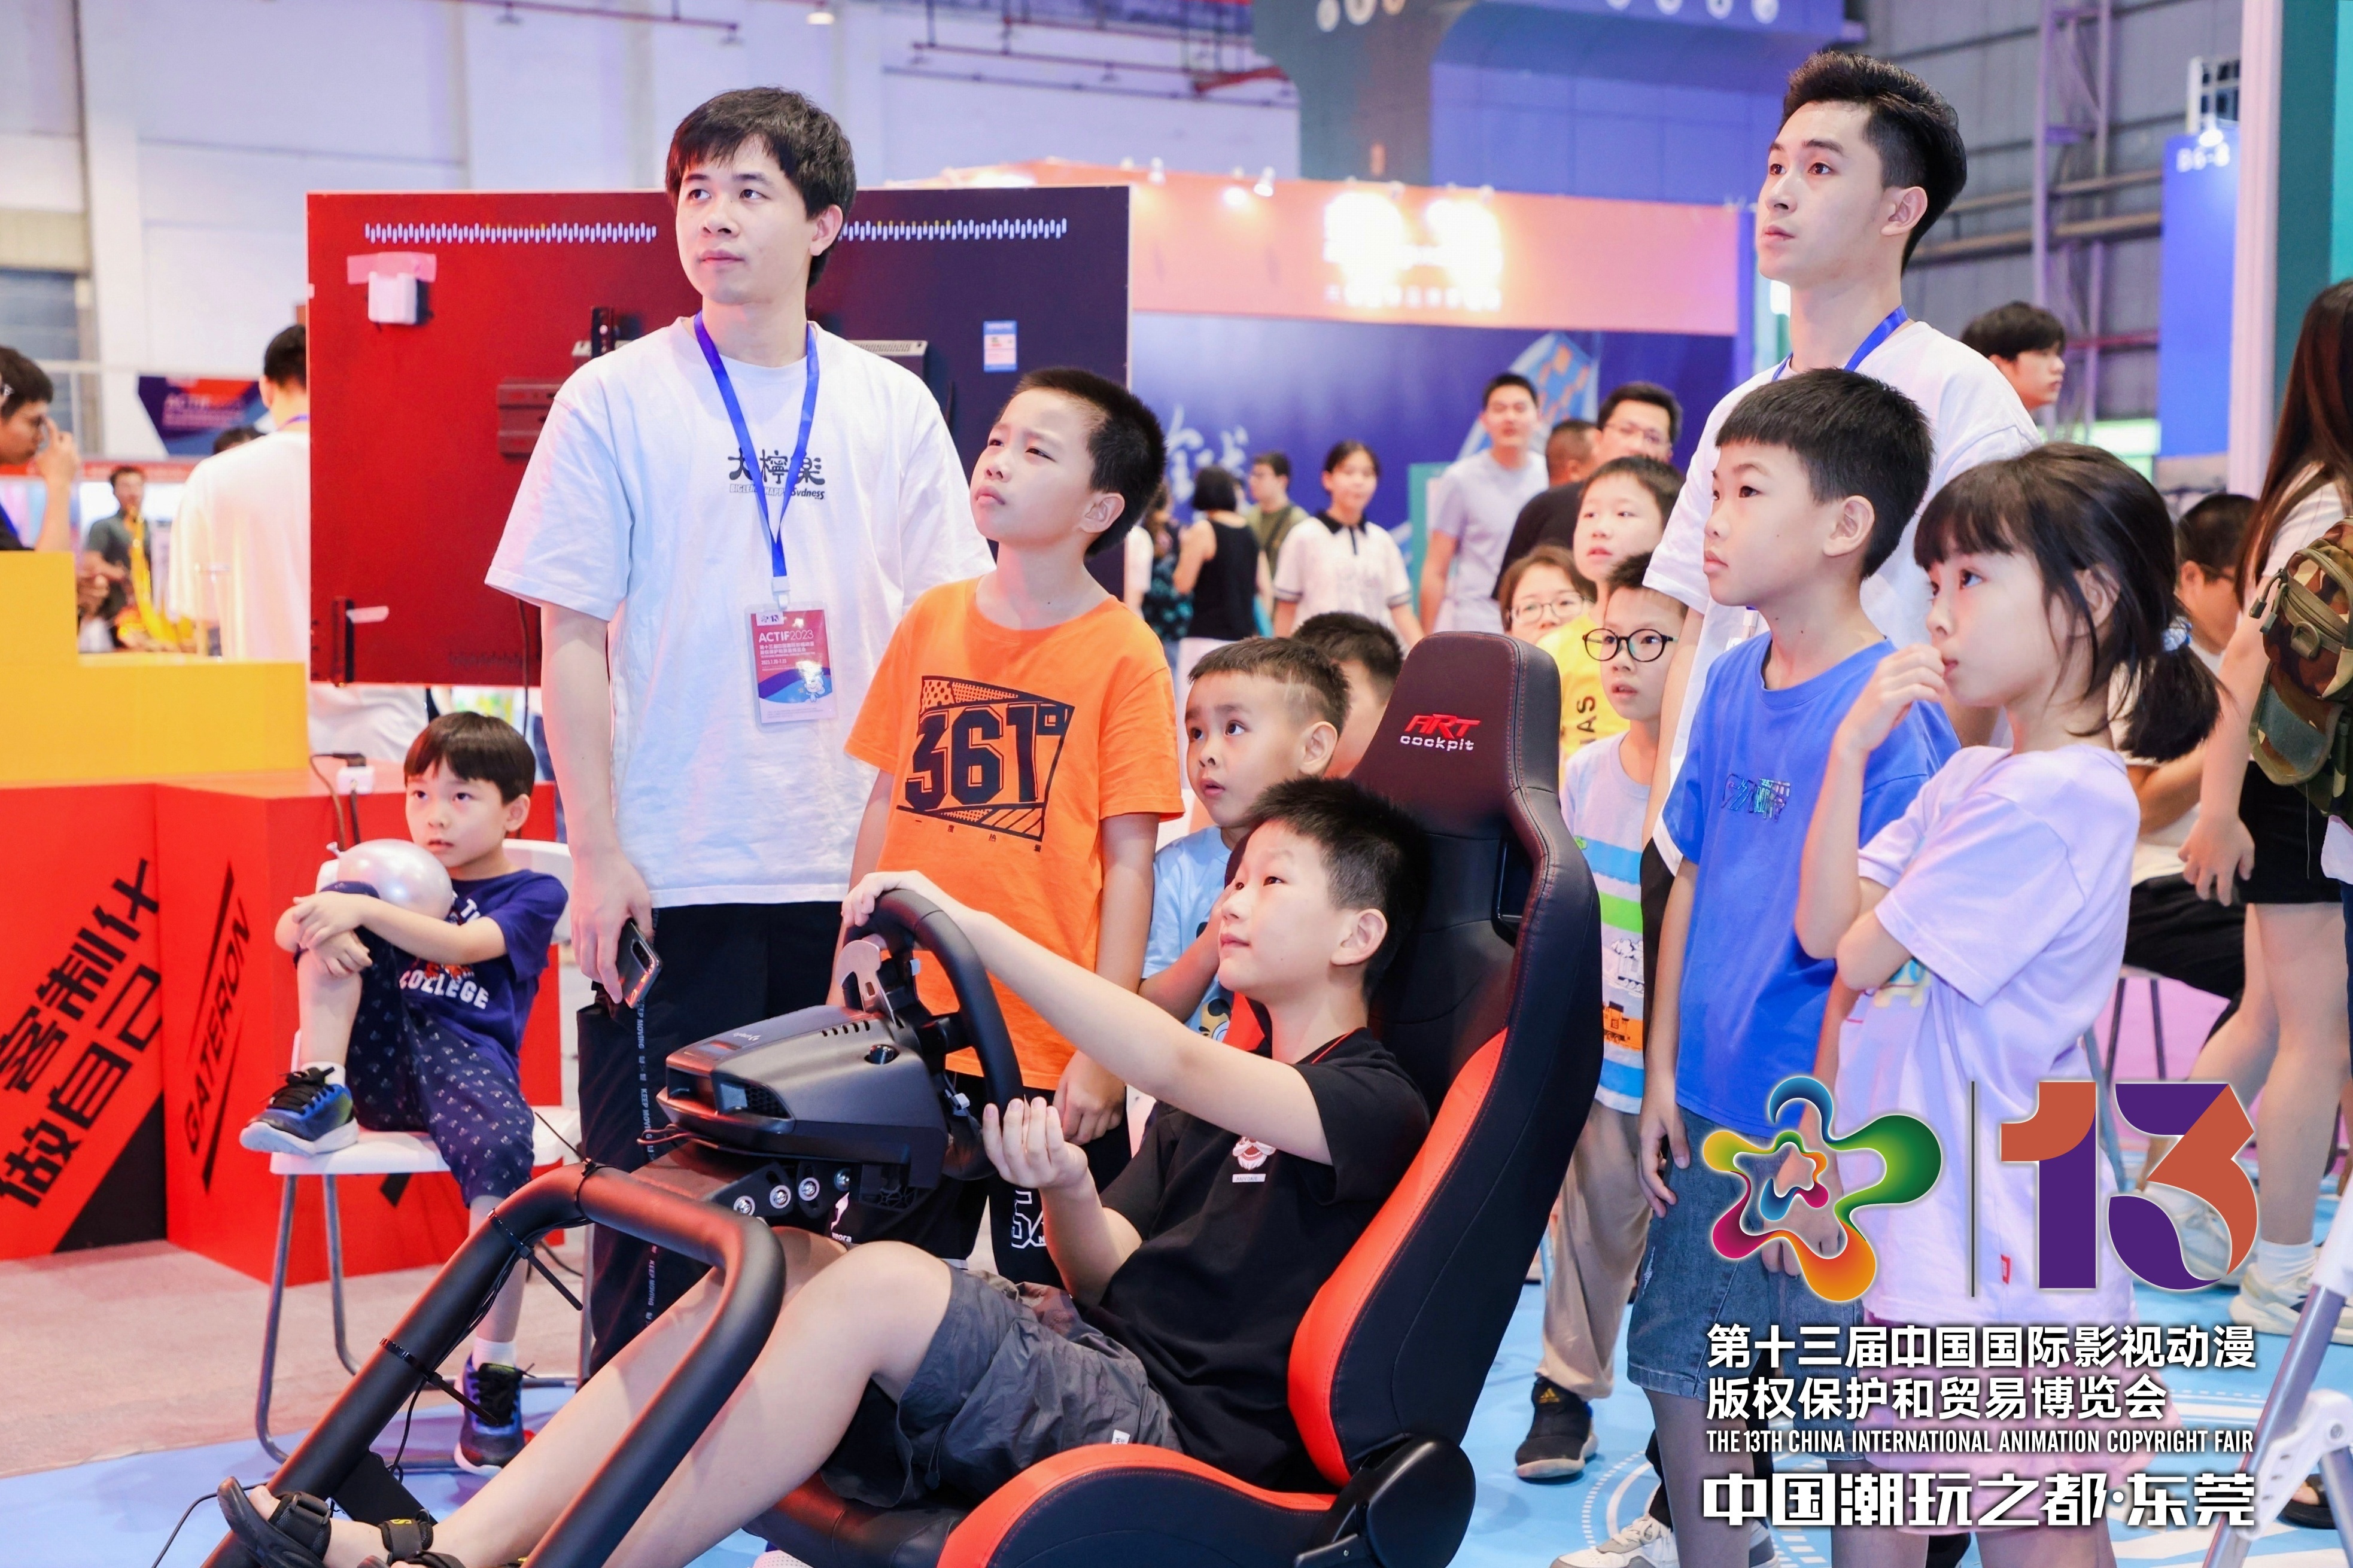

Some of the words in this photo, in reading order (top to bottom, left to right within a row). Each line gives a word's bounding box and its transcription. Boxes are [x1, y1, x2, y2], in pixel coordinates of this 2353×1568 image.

[764, 486, 785, 497] HAPP
[759, 629, 814, 643] ACTIF2023
[1404, 714, 1482, 739] ART
[1400, 735, 1475, 751] cockpit
[399, 969, 490, 1010] COLLEGE
[184, 897, 250, 1155] GATERON
[0, 963, 162, 1208] 做自己
[640, 1088, 649, 1108] KEEP
